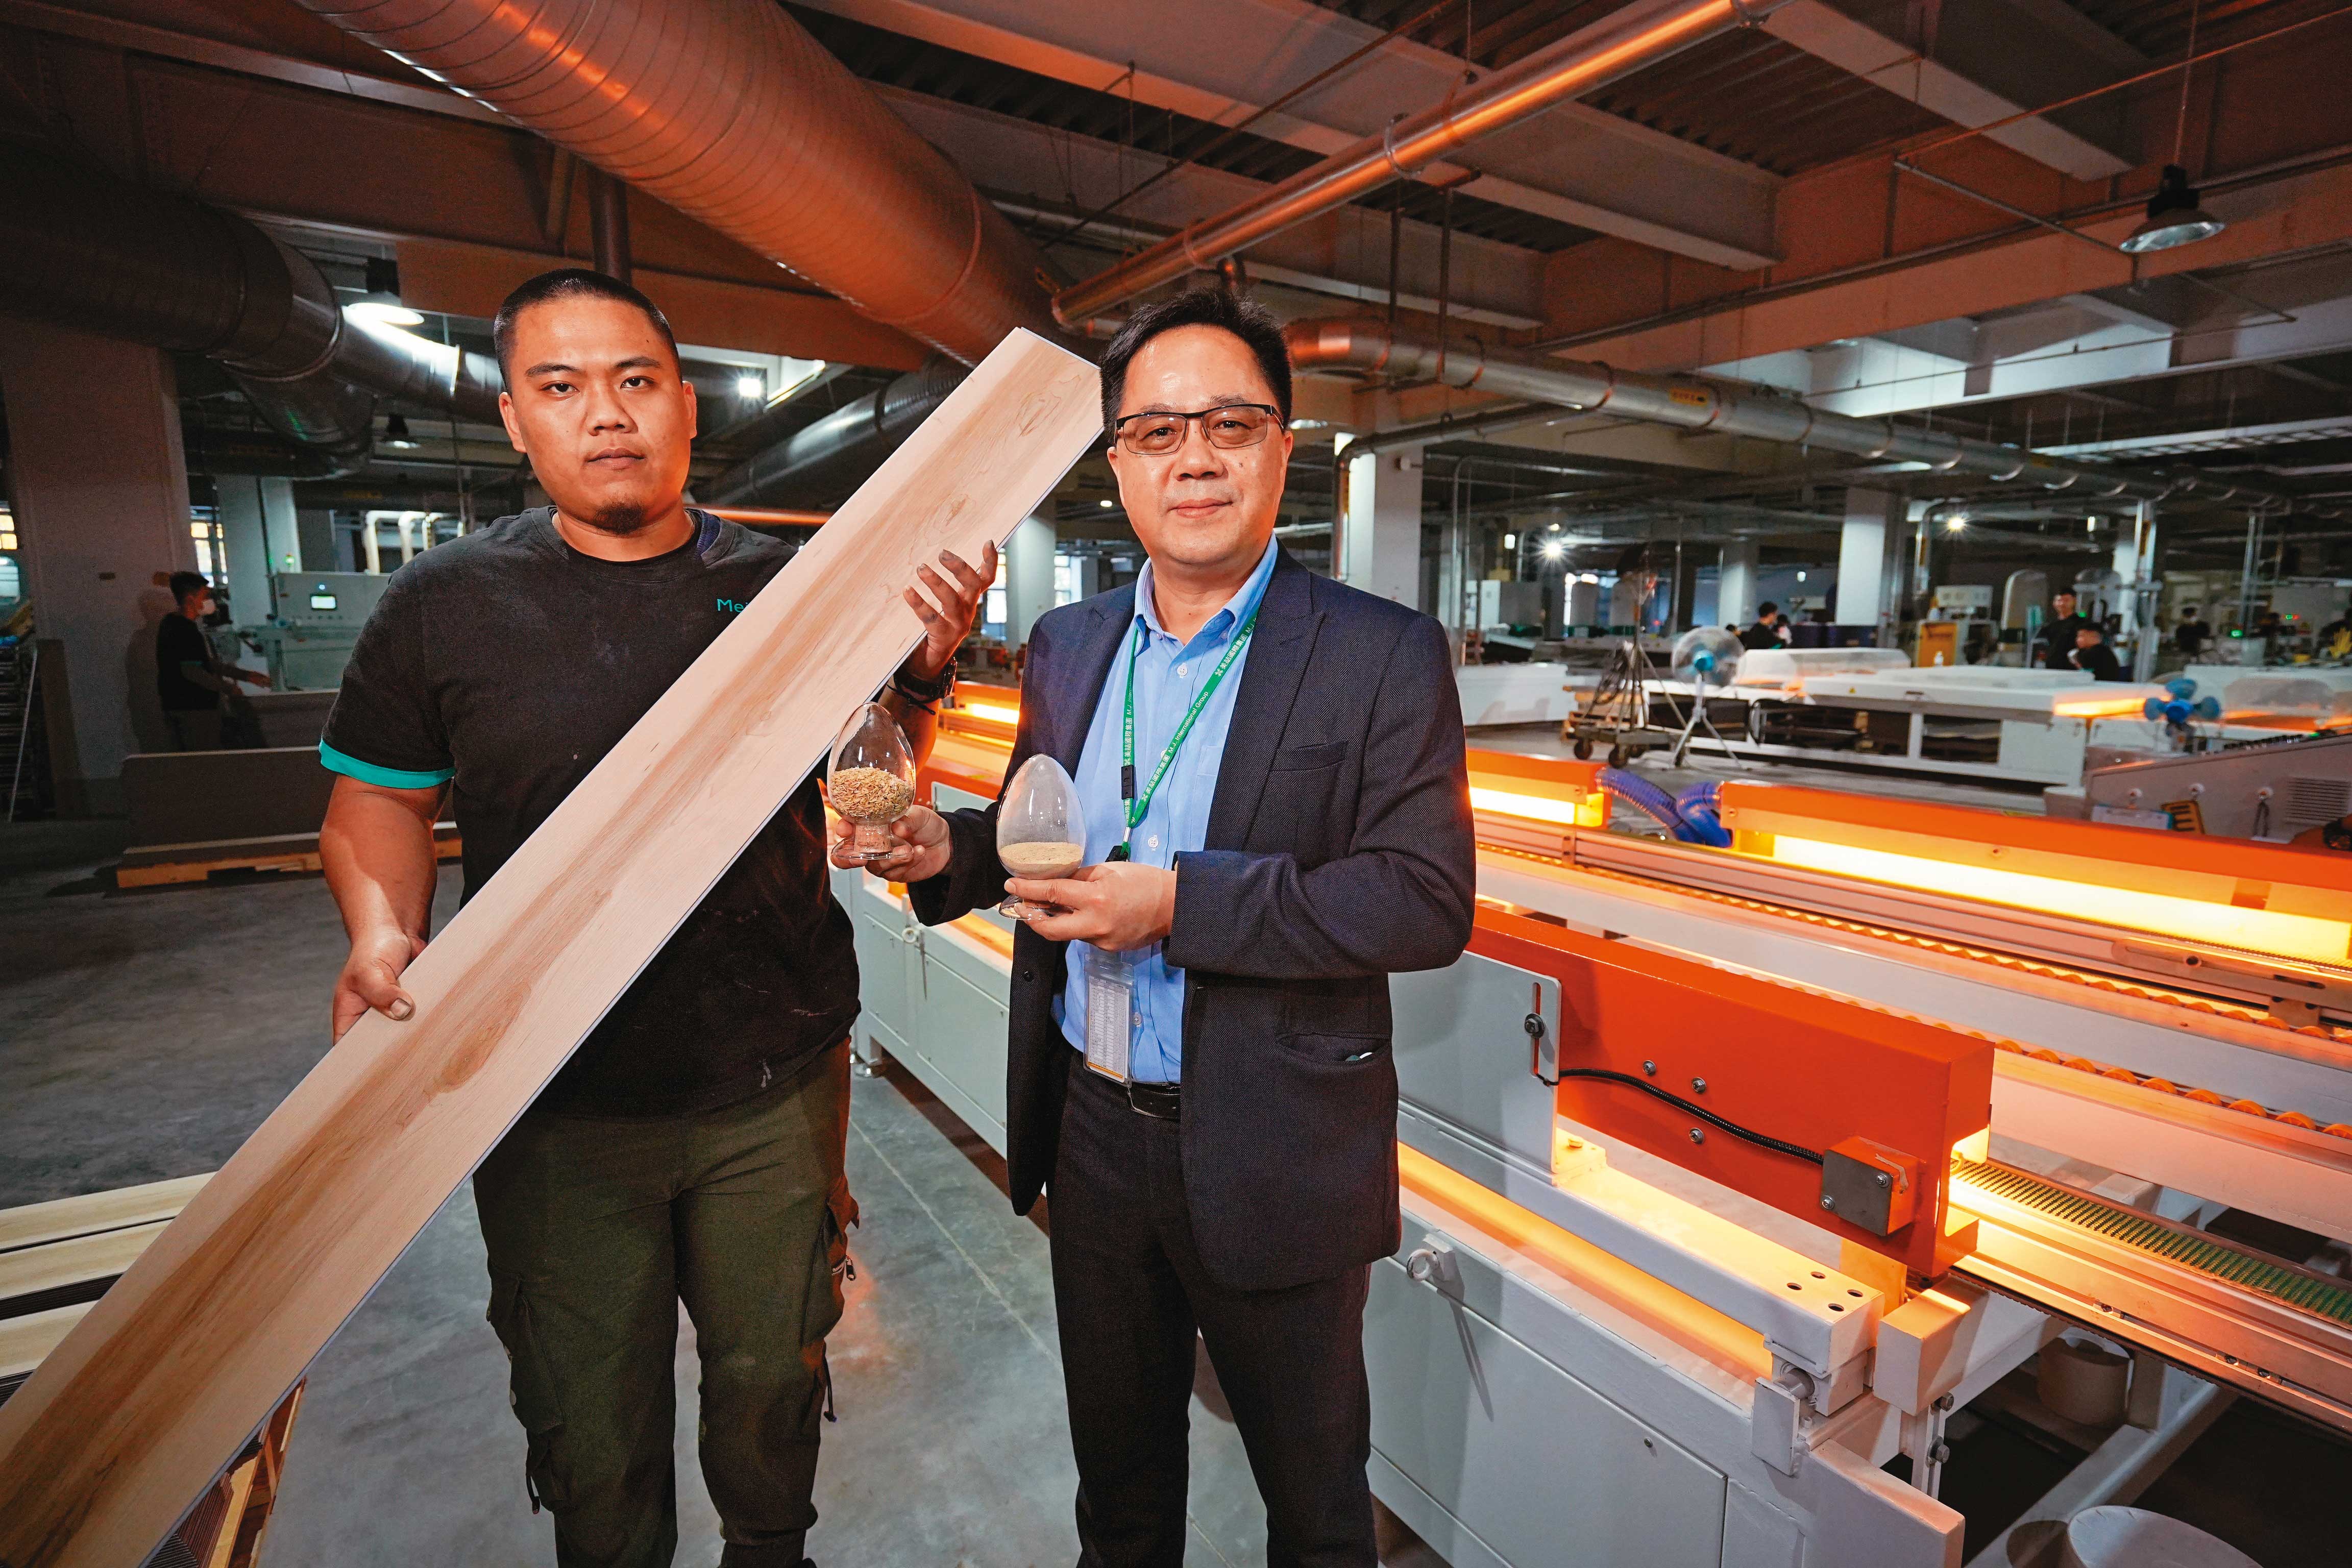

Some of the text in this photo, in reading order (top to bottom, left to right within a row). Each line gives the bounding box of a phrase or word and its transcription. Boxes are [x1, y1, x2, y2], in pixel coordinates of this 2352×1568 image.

[717, 598, 749, 612] Me
[1175, 707, 1197, 741] International
[1195, 691, 1209, 708] Group
